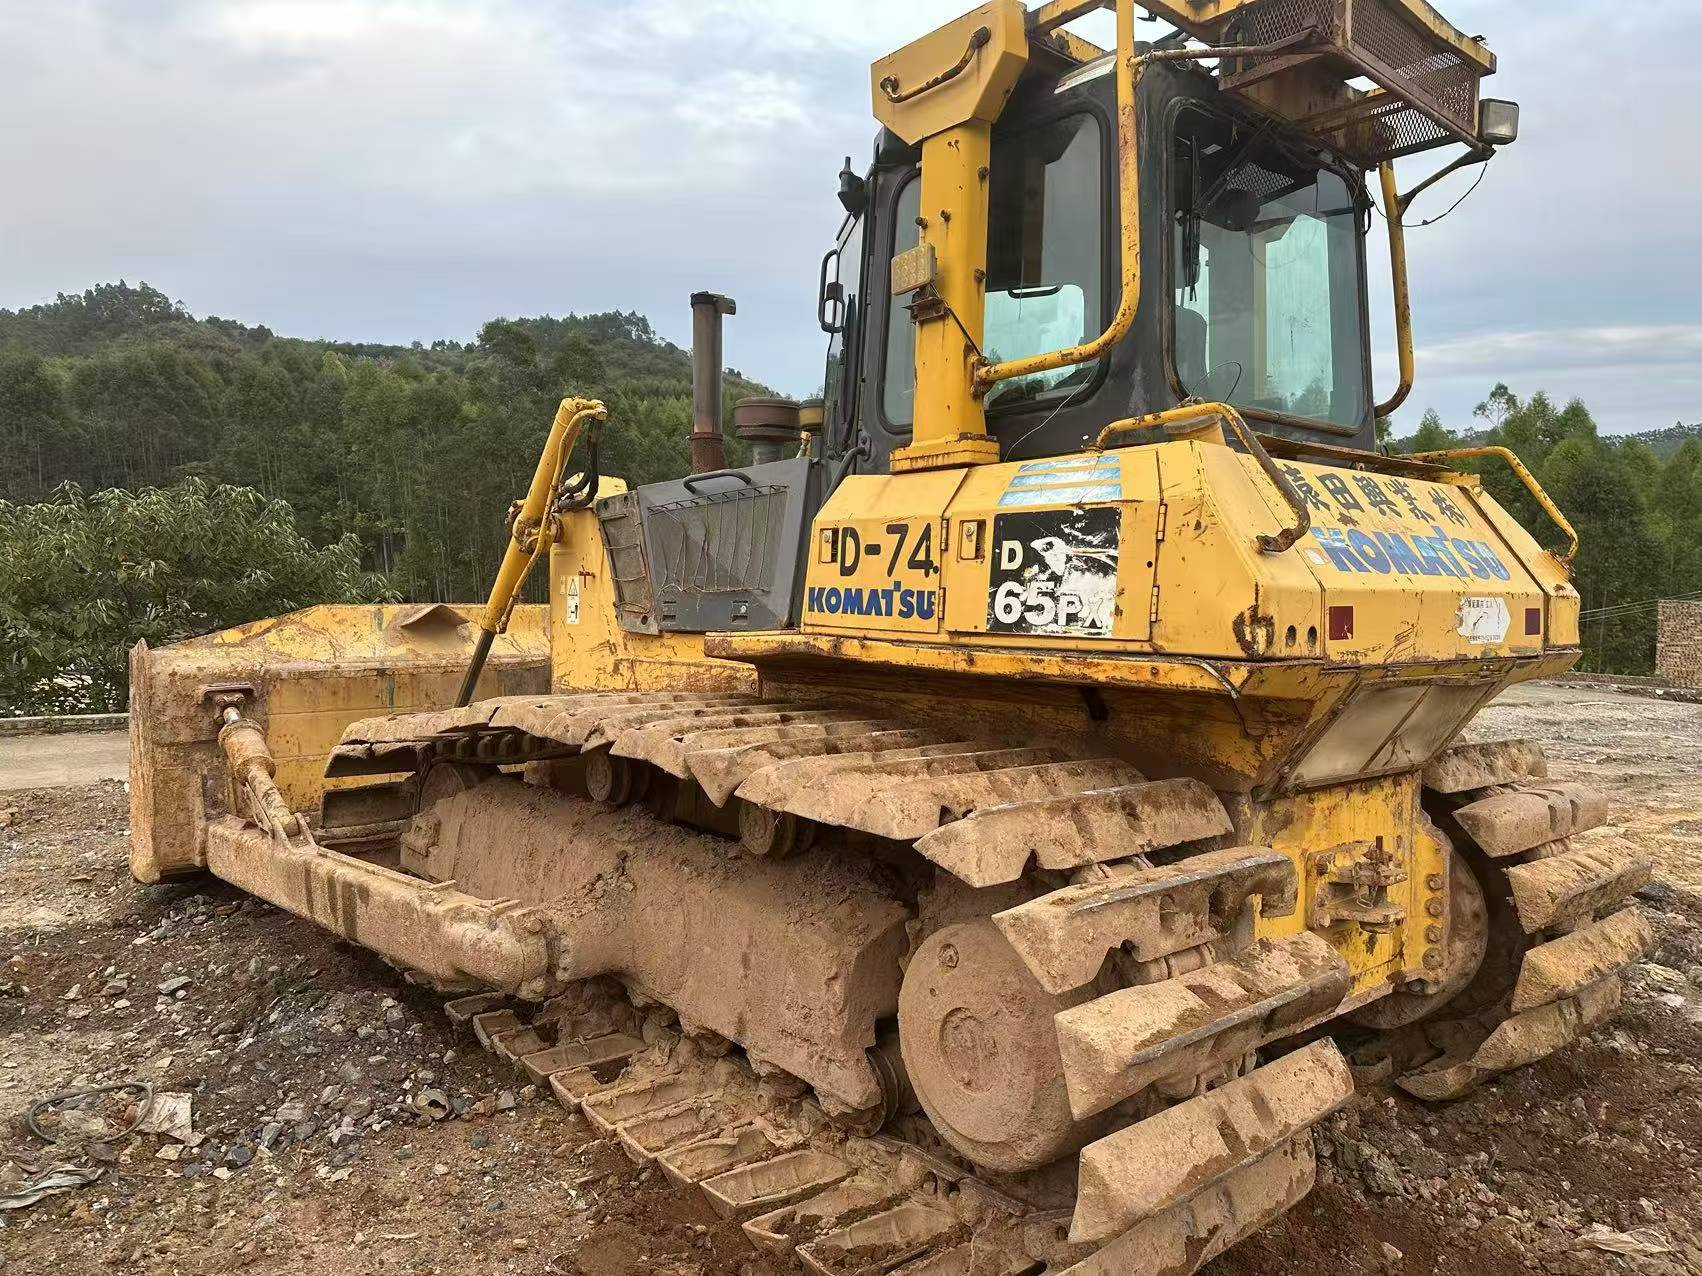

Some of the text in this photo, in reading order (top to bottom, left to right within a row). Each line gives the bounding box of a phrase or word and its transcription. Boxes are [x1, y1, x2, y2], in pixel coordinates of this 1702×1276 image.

[1001, 540, 1024, 570] D
[1310, 525, 1511, 581] KOMATSU
[808, 580, 937, 620] KOMATSU
